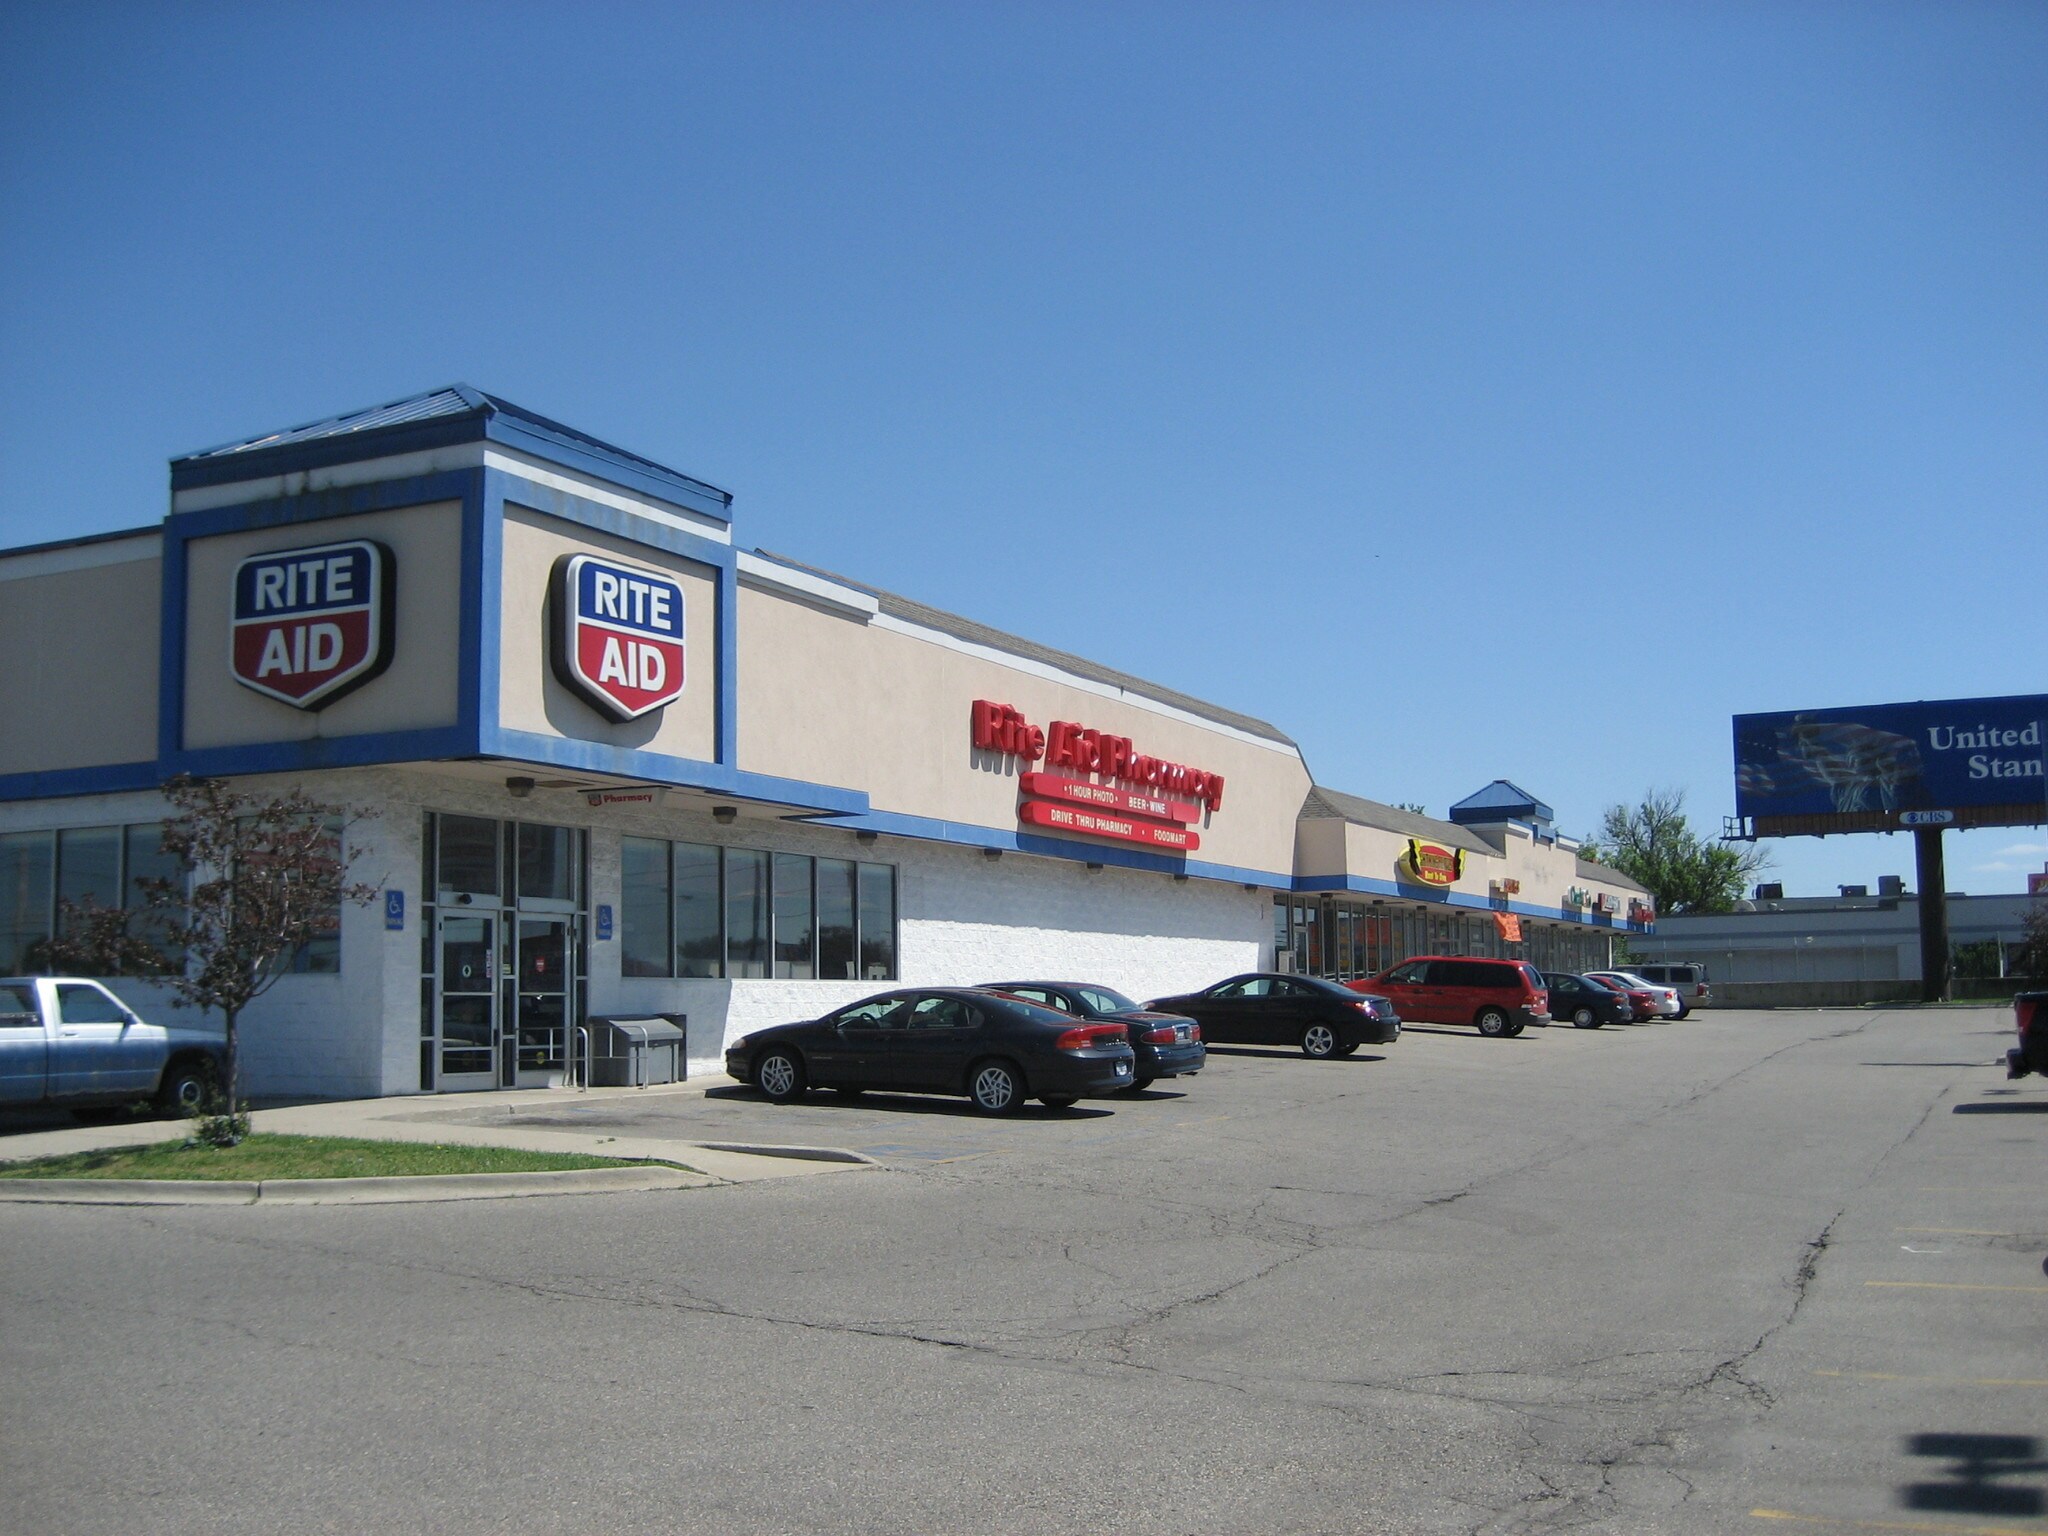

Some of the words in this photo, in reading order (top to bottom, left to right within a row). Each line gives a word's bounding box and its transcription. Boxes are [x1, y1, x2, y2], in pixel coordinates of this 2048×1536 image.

[255, 555, 353, 611] RITE
[595, 571, 672, 630] RITE
[257, 622, 344, 678] AID
[599, 636, 666, 692] AID
[972, 699, 1045, 761] Rite
[1045, 720, 1100, 774] Aid
[1927, 721, 2041, 750] United
[1968, 754, 2044, 779] Stan
[603, 794, 653, 803] Pharmacy
[1068, 785, 1073, 796] 1
[1073, 786, 1092, 799] HOUR
[1092, 790, 1114, 804] PHOTO
[1051, 809, 1073, 825] DRIVE
[1076, 814, 1096, 829] THRU
[1096, 819, 1133, 836] PHARMACY
[1153, 829, 1187, 845] FOODMART
[1920, 811, 1946, 822] CBS
